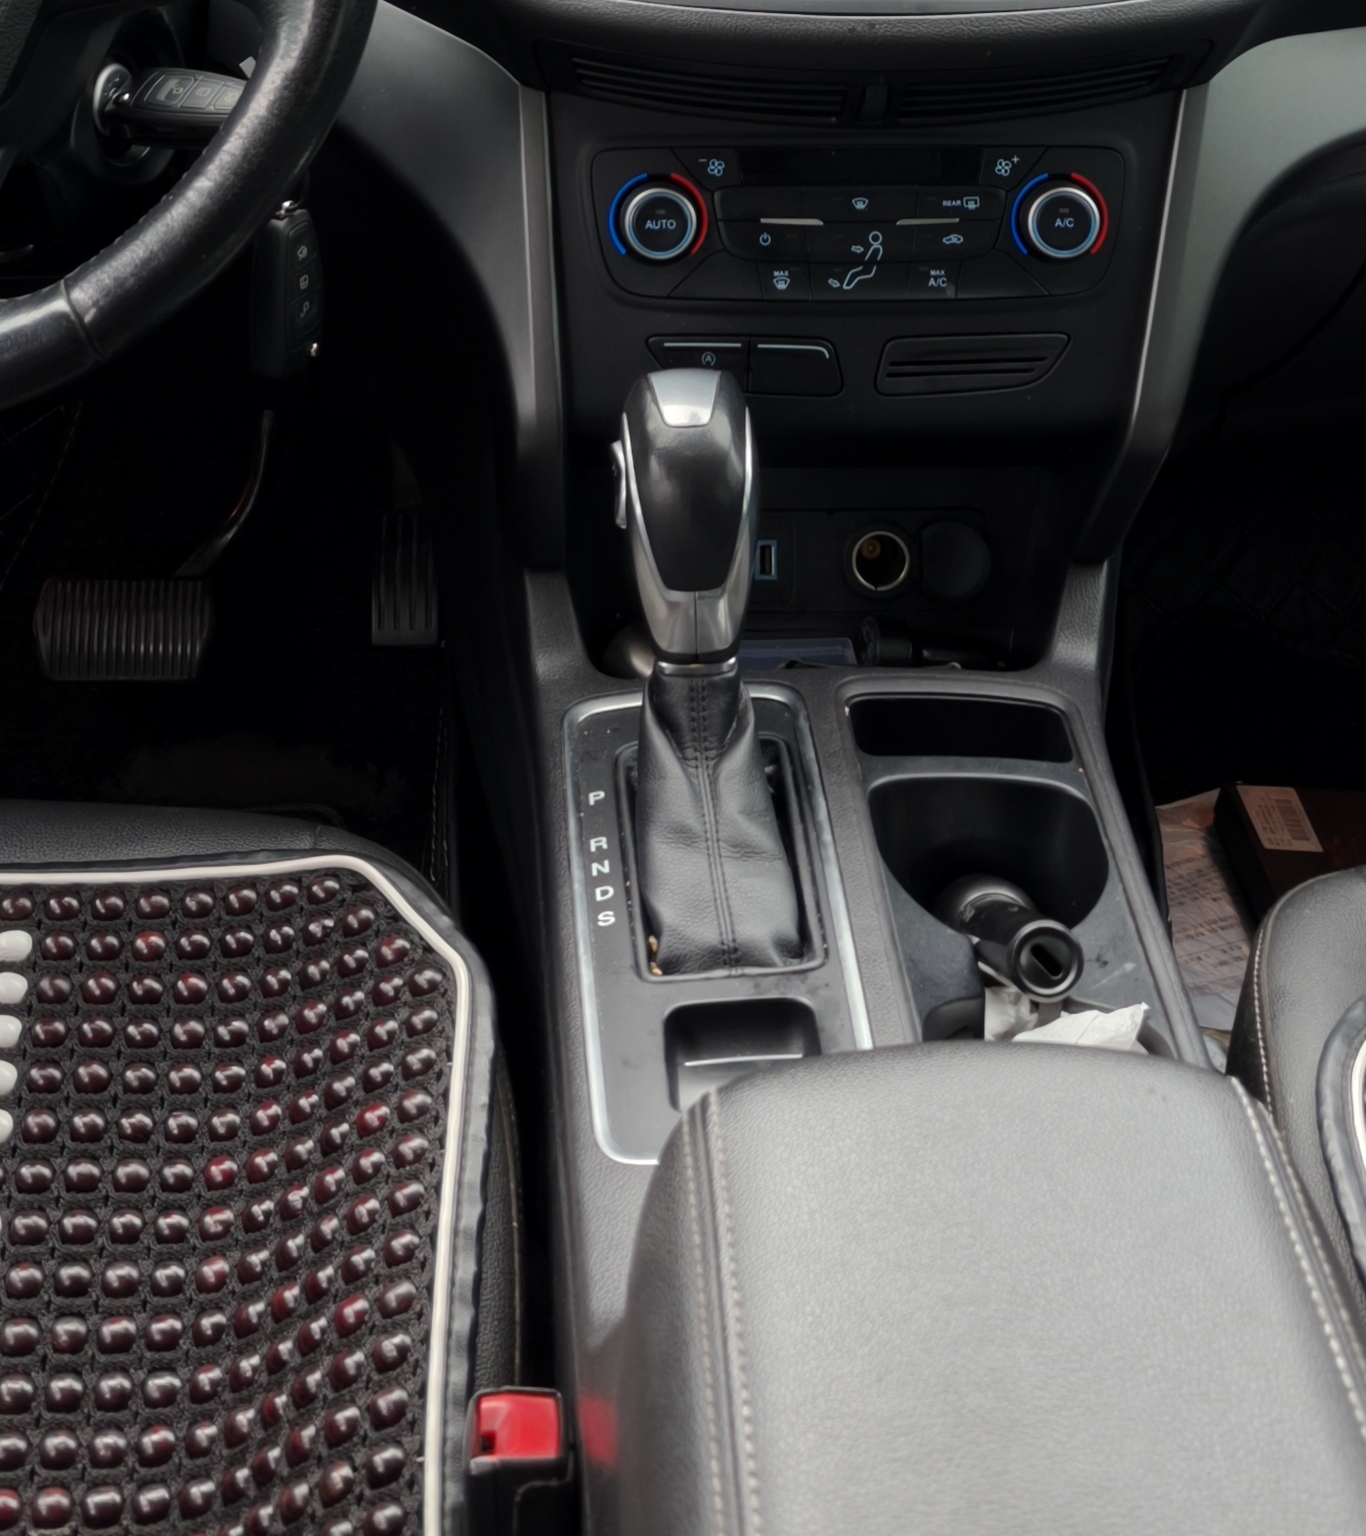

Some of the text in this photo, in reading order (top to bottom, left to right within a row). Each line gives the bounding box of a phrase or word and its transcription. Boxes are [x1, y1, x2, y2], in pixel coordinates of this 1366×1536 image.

[942, 199, 961, 207] REAR
[645, 218, 677, 231] AUTO
[1054, 217, 1075, 229] A/C
[928, 277, 947, 288] A/C
[588, 790, 605, 806] P
[589, 836, 608, 852] R
[591, 859, 610, 877] N
[595, 885, 614, 902] D
[597, 910, 616, 927] S
